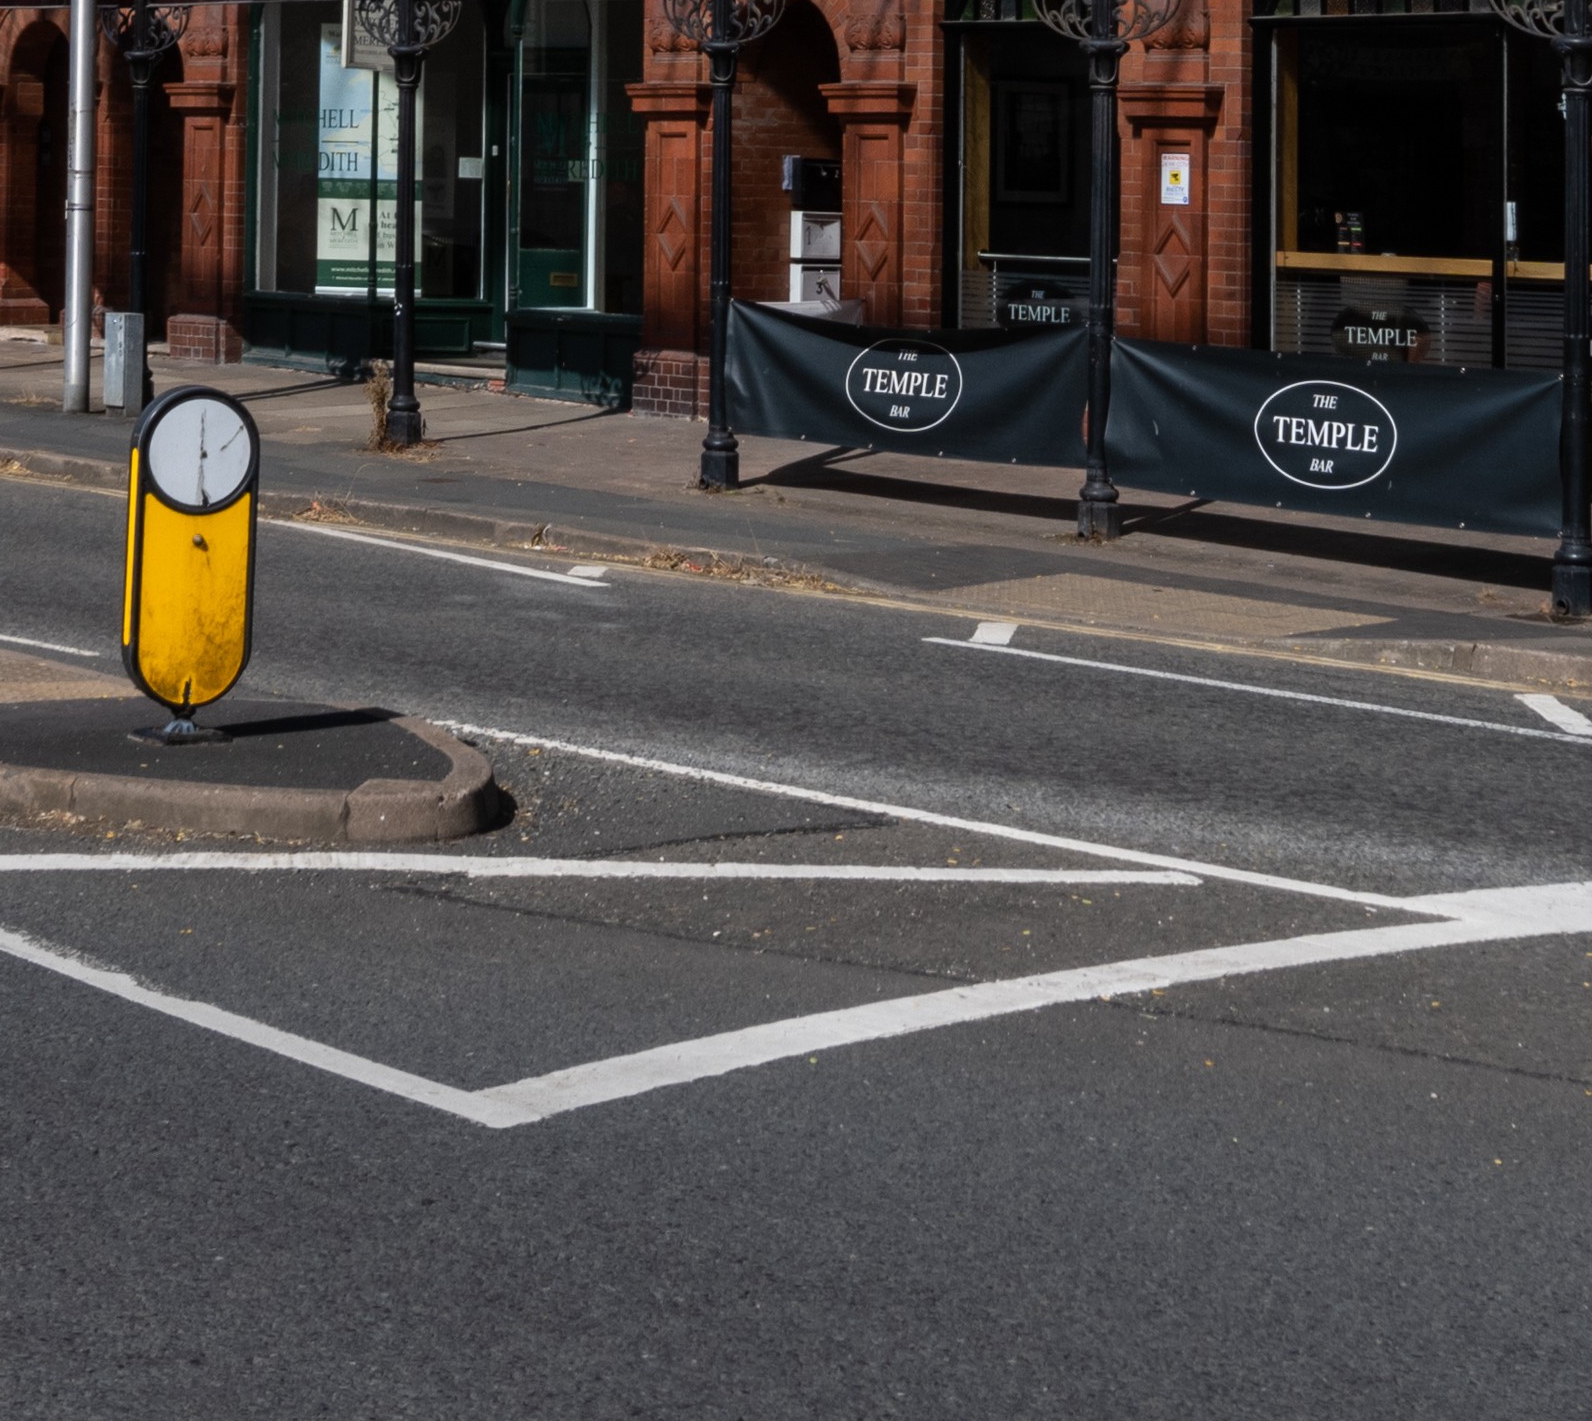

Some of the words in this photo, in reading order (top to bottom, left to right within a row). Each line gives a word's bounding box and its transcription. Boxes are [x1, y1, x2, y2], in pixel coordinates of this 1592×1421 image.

[331, 207, 359, 232] M
[816, 281, 825, 295] 3
[1031, 290, 1046, 299] THE
[1008, 303, 1071, 324] TEMPLE
[1371, 311, 1388, 321] THE
[1344, 326, 1418, 347] TEMPLE
[897, 349, 918, 362] THE
[1371, 352, 1389, 362] BAR
[862, 367, 950, 399] TEMPLE
[1312, 393, 1339, 410] THE
[889, 404, 911, 418] BAR
[1273, 415, 1379, 452] TEMPLE
[1309, 458, 1335, 474] BAR
